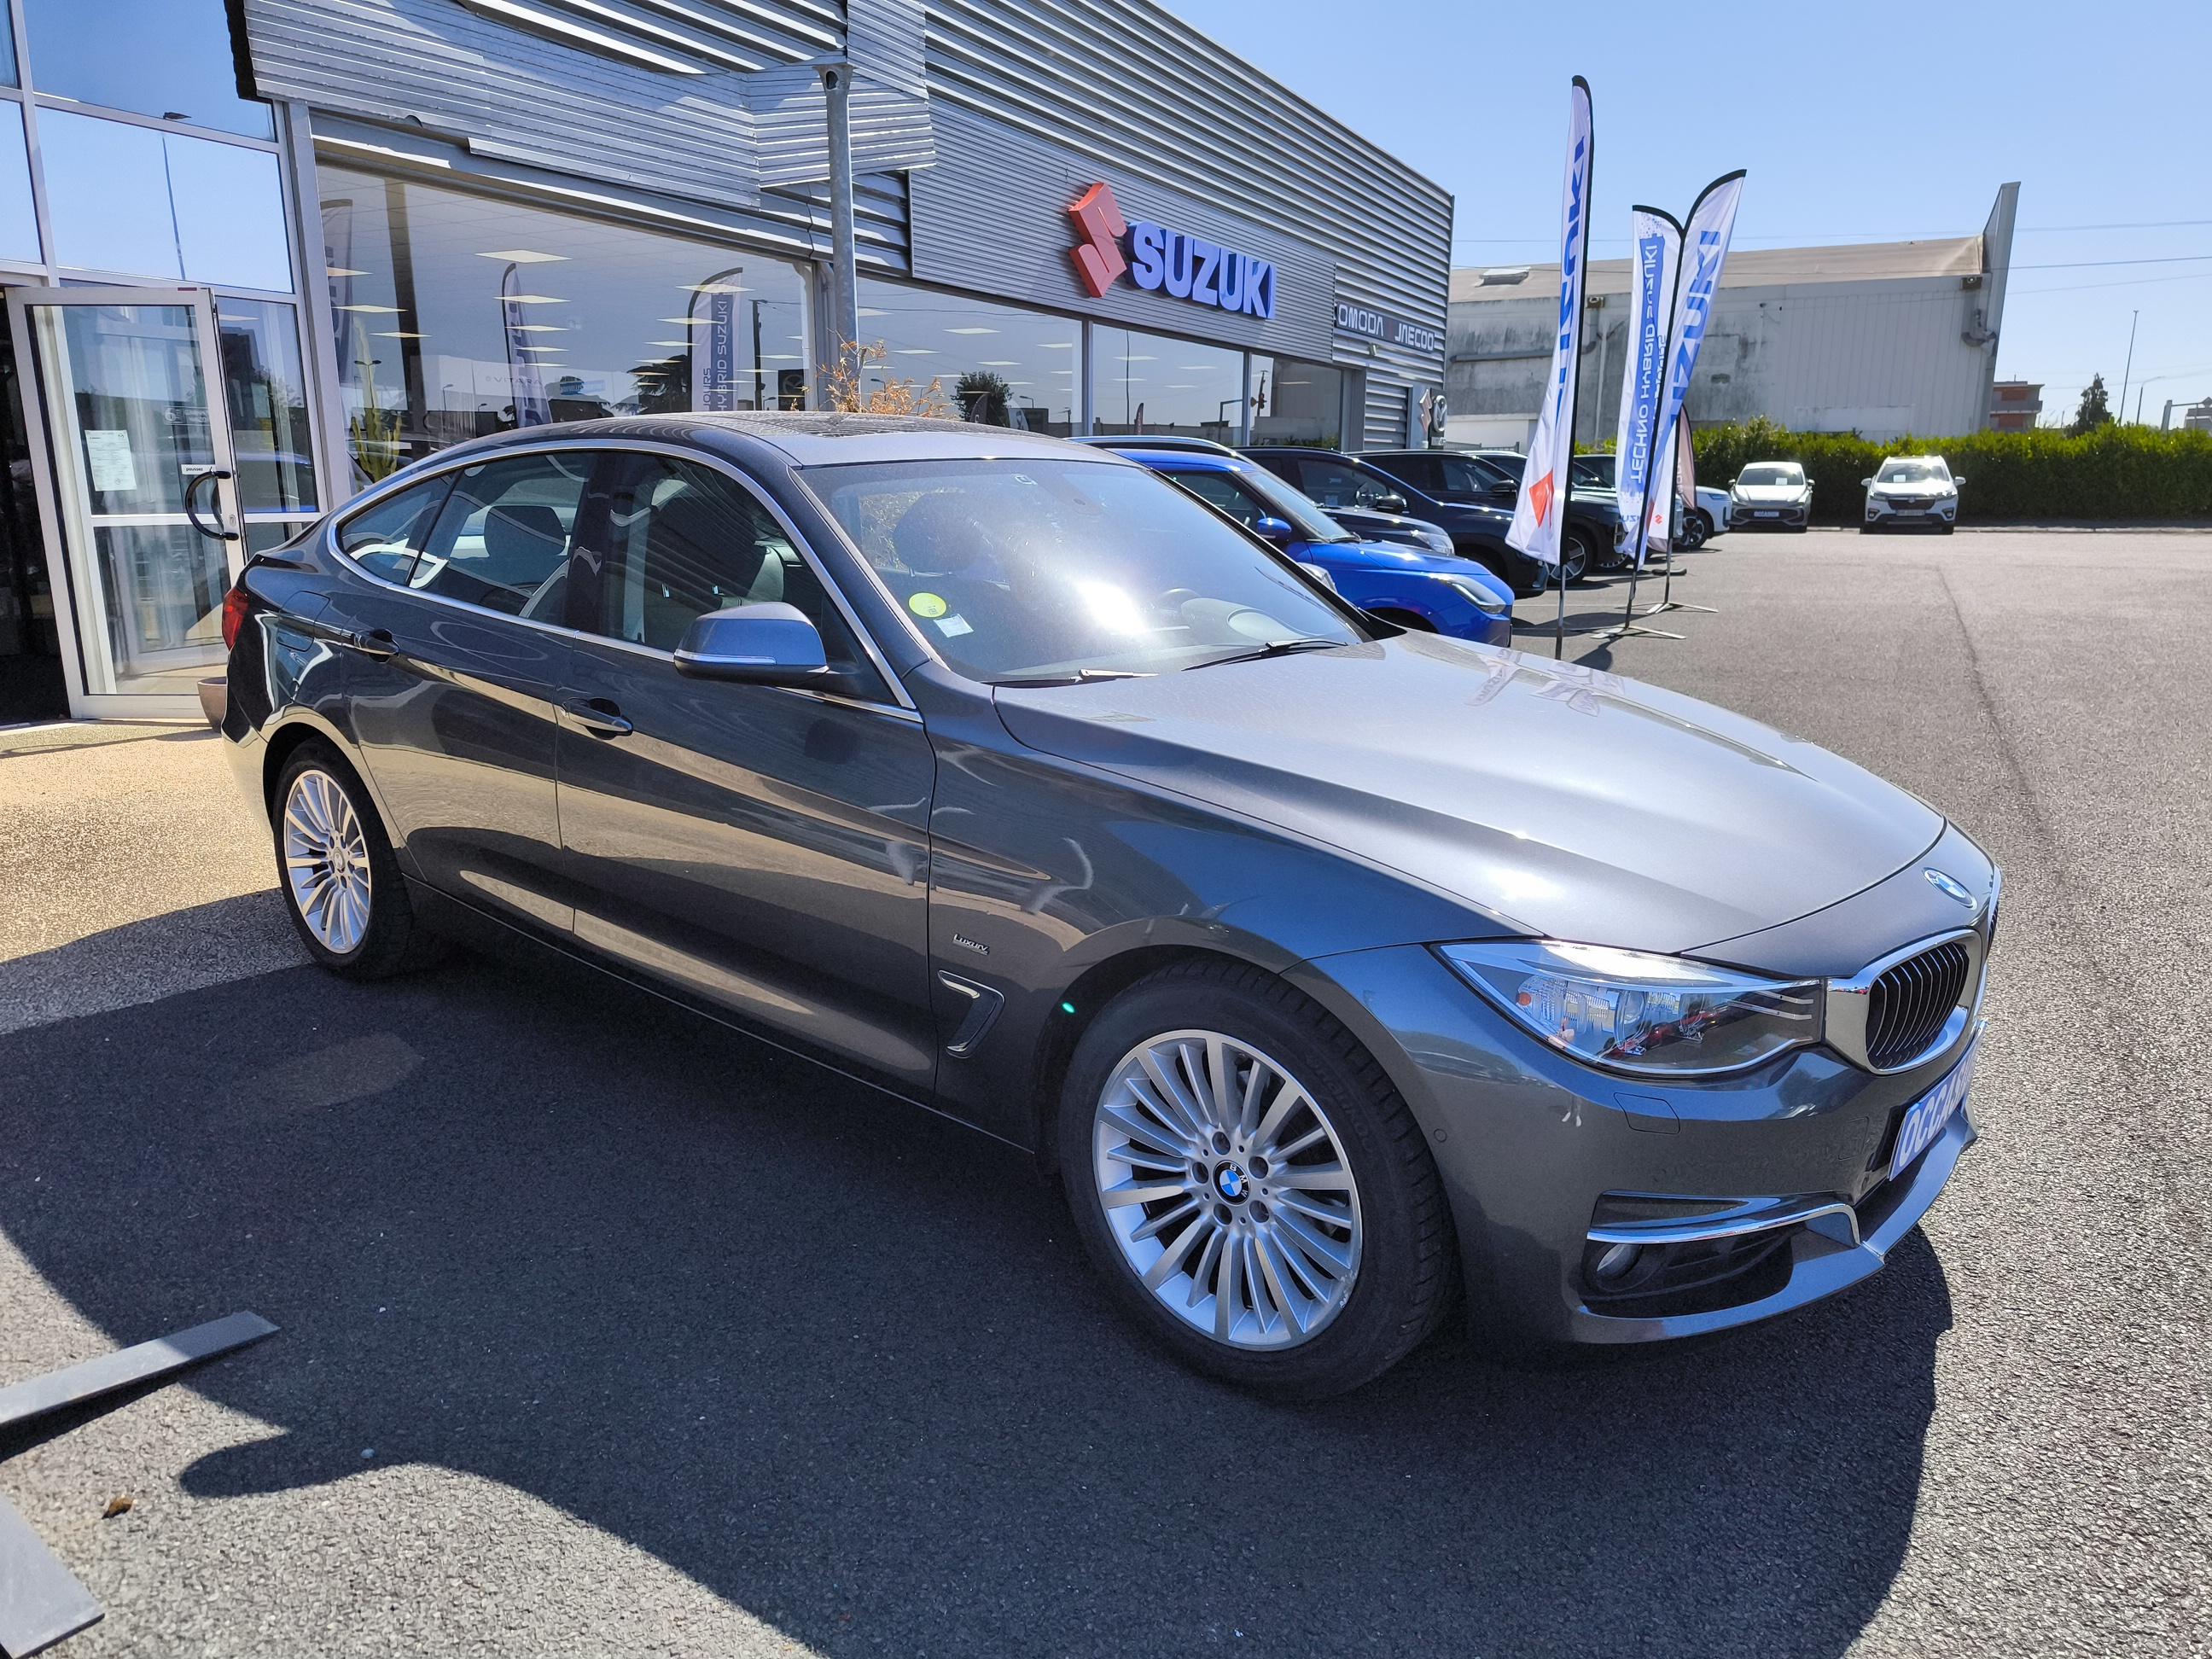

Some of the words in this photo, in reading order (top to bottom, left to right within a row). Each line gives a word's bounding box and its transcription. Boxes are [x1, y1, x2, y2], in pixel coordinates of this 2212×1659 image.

[1126, 220, 1276, 319] SUZUKI
[717, 300, 727, 356] SUZUKI
[1338, 304, 1383, 337] OMODA
[1394, 323, 1435, 352] JAECOO
[1229, 1162, 1249, 1198] BMW
